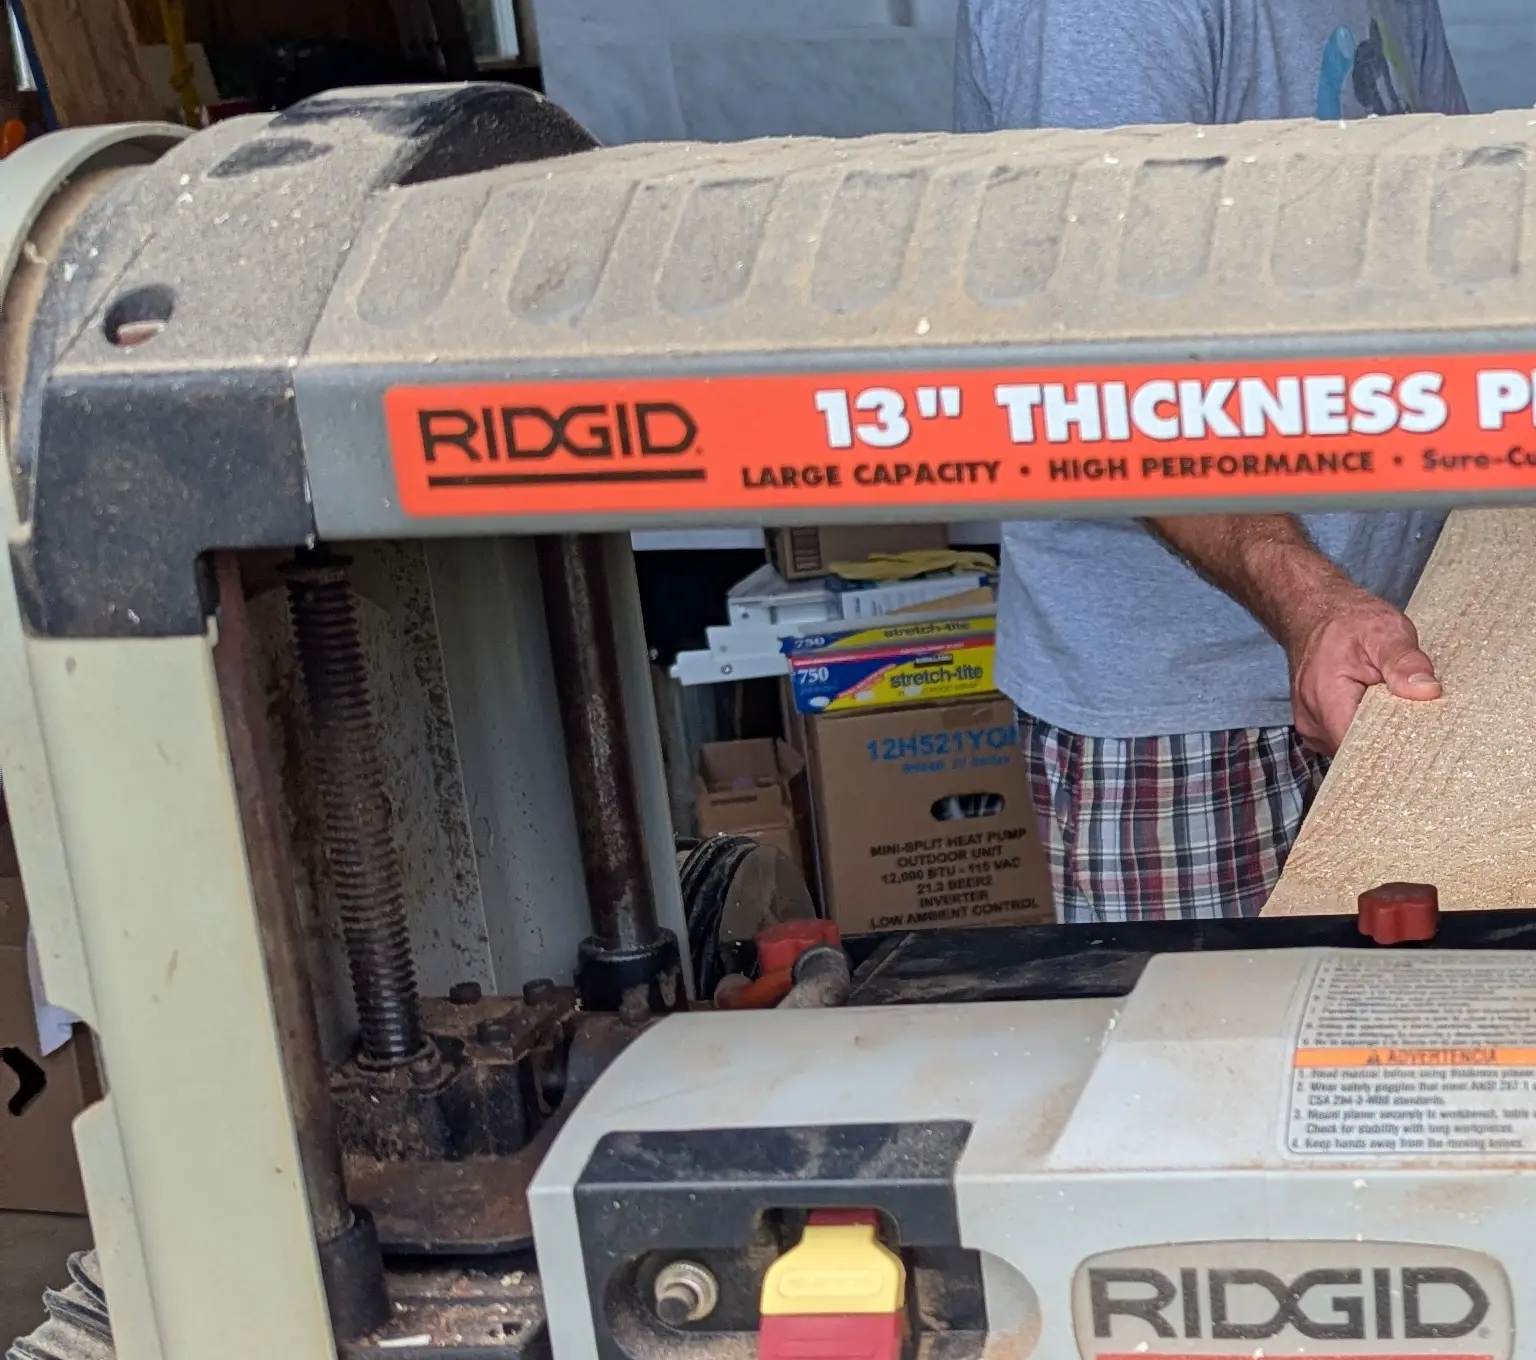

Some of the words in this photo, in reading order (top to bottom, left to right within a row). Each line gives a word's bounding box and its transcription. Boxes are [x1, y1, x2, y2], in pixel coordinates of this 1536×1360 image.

[418, 402, 701, 462] RIDGID
[815, 384, 961, 450] 13"
[996, 370, 1445, 445] THICKNESS
[741, 464, 842, 489] LARGE
[854, 460, 1001, 487] CAPACITY
[1049, 456, 1130, 481] HIGH
[1142, 449, 1374, 478] PERFORMANCE
[798, 667, 829, 683] 750
[890, 664, 984, 688] stretch-tite
[871, 838, 943, 856] MINI-SPLIT
[947, 833, 983, 847] HEAT
[987, 827, 1027, 842] PUMP
[898, 850, 967, 868] OUTDOOR
[972, 845, 1003, 858] UNIT
[881, 869, 923, 884] 12,000
[927, 865, 956, 879] BTU
[993, 857, 1021, 871] VAC
[920, 890, 989, 908] INVERTER
[871, 915, 903, 930] LOW
[907, 906, 968, 924] AMBIENT
[972, 898, 1039, 916] CONTROL
